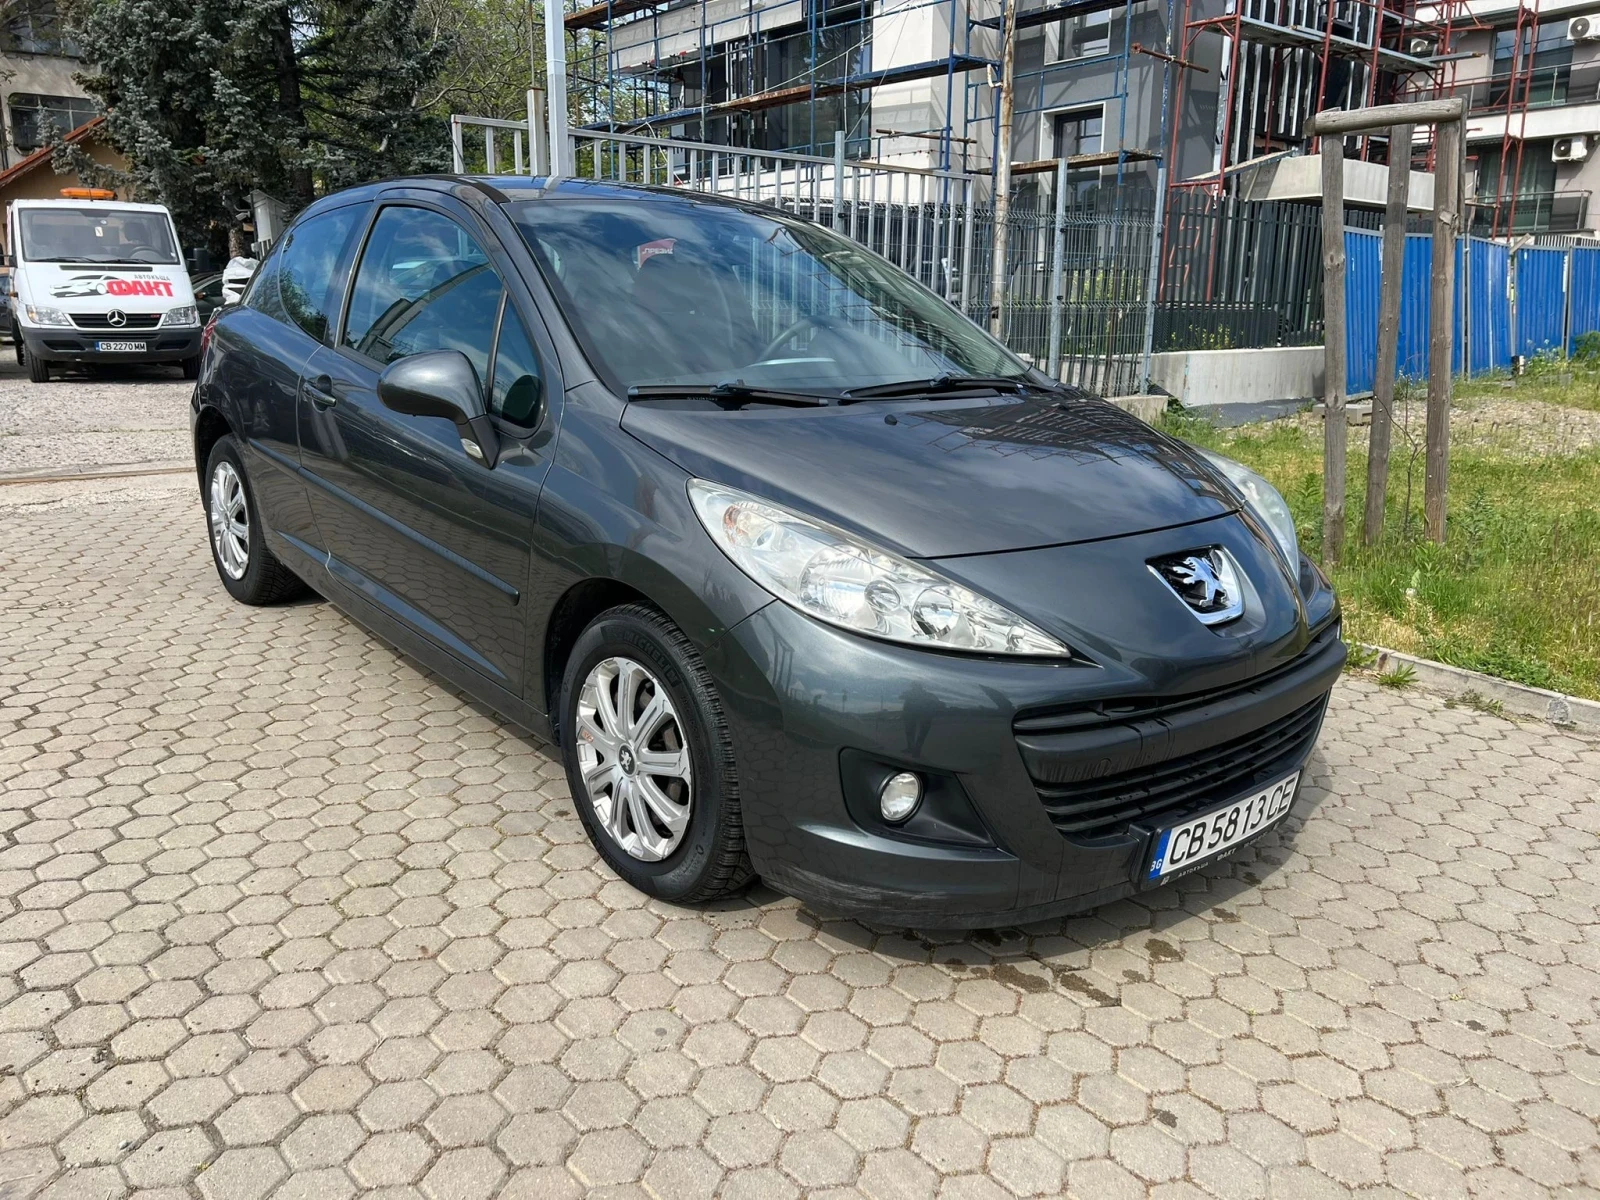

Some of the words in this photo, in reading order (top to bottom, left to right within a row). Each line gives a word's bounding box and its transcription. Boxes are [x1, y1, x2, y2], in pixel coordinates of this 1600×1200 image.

[107, 280, 173, 297] ФАКТ
[113, 342, 133, 350] 2270
[1169, 821, 1206, 865] CB
[1207, 795, 1267, 849] 5813
[1266, 777, 1296, 820] CE
[1150, 859, 1162, 872] BG
